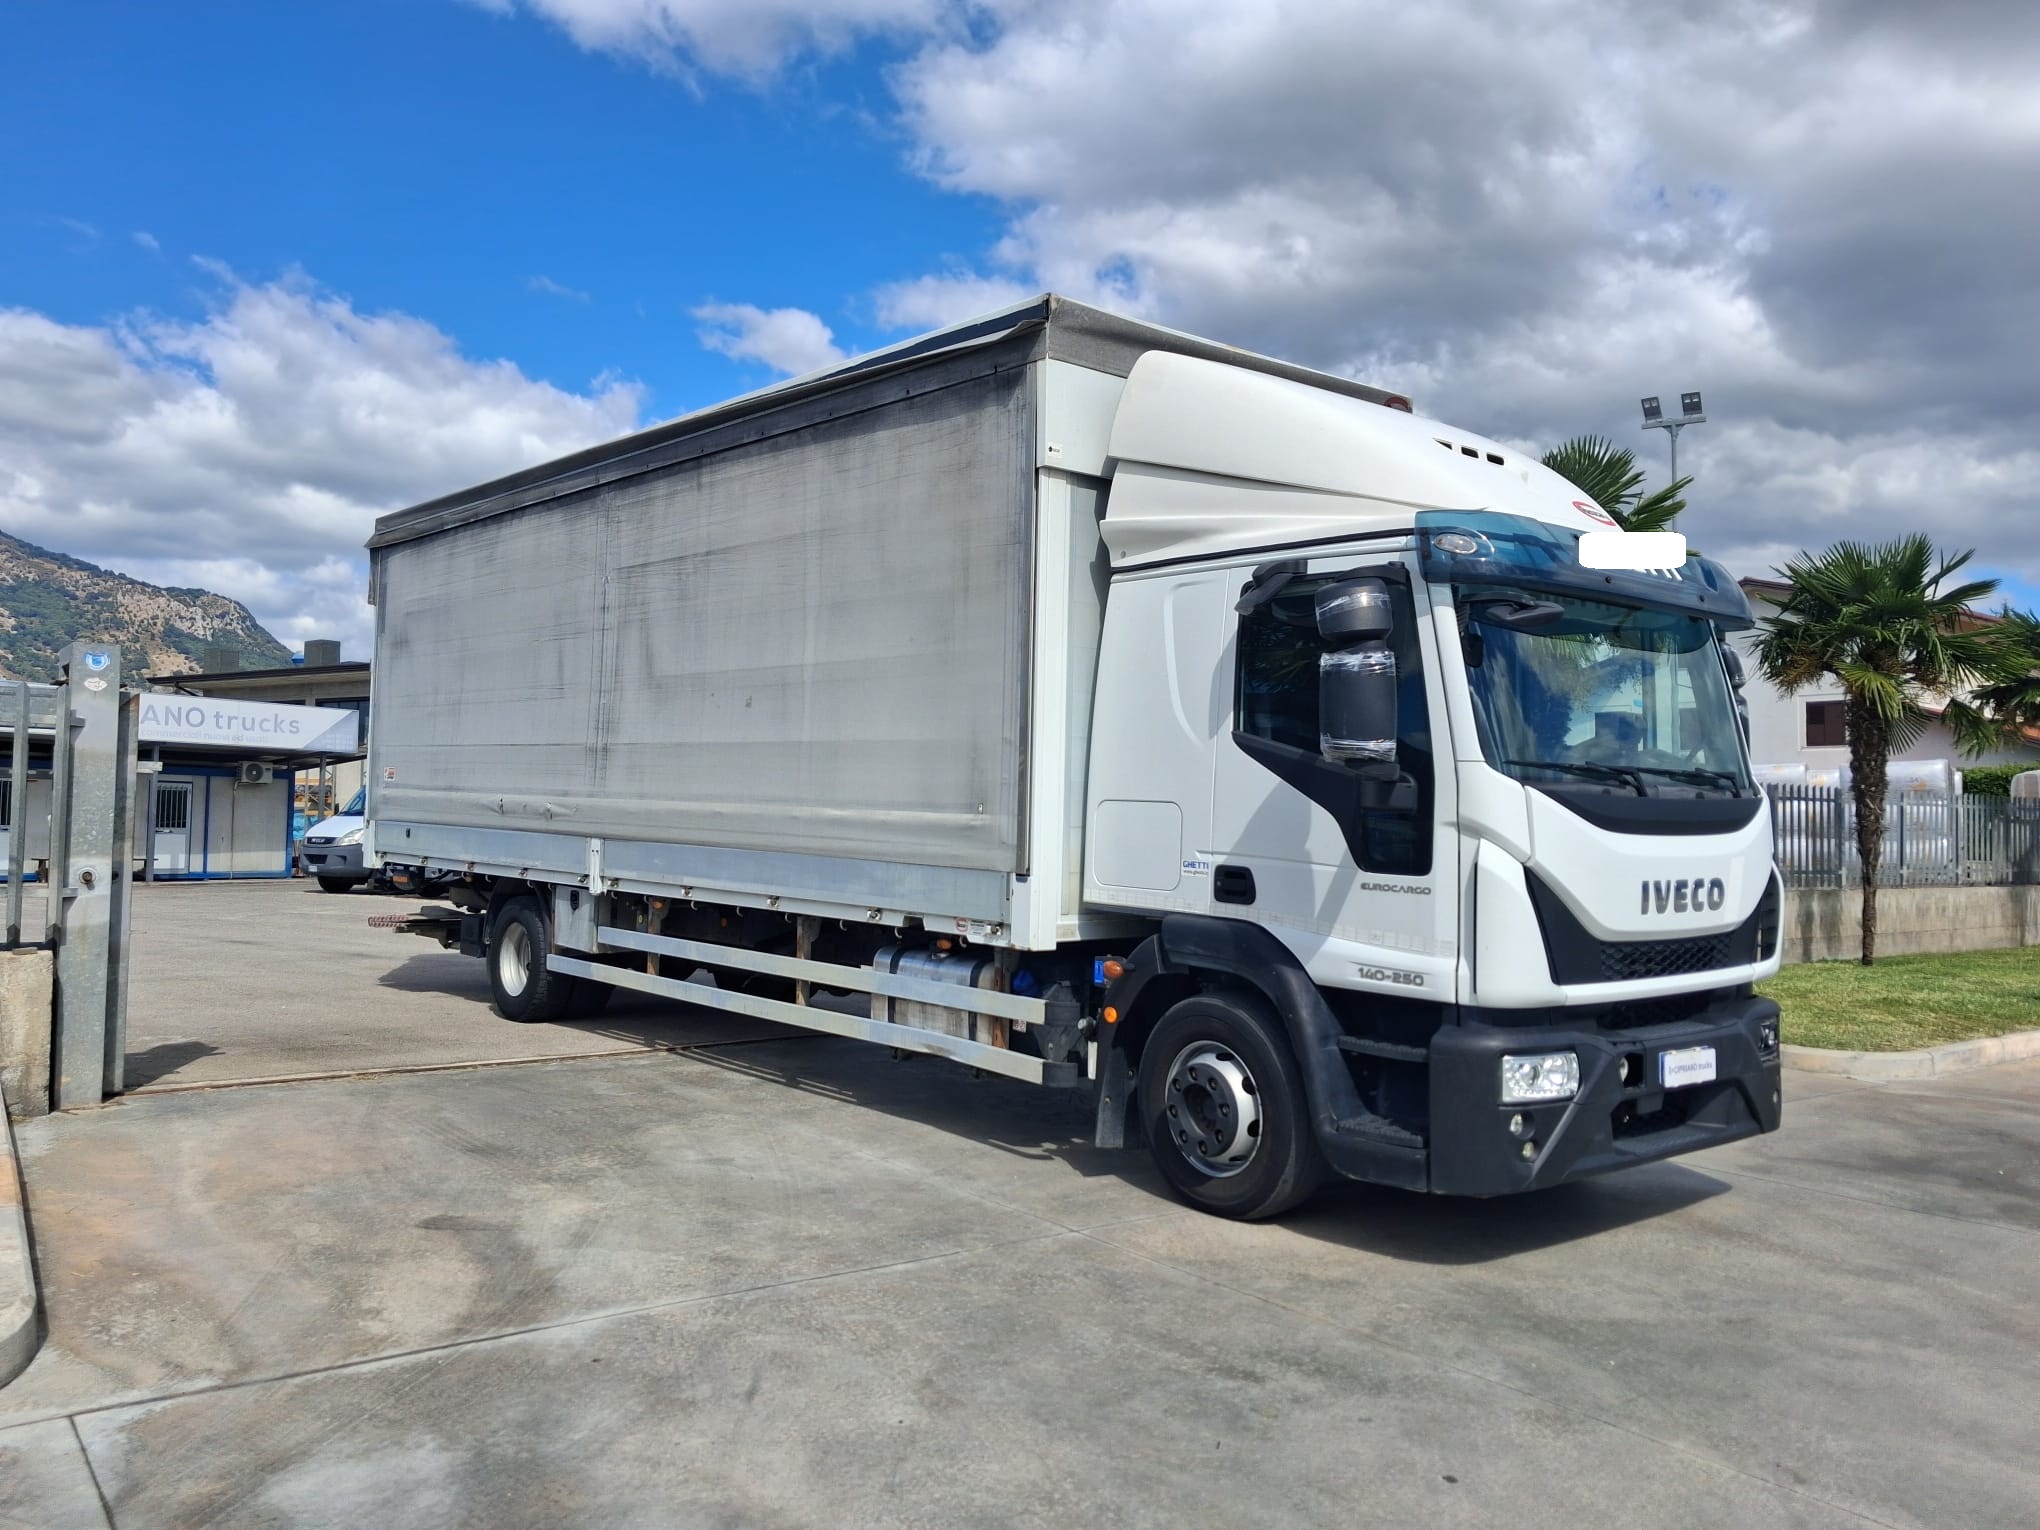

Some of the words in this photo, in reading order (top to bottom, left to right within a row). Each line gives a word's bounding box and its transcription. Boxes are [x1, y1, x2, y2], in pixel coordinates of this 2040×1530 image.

[140, 704, 205, 728] ANO
[213, 711, 300, 734] trucks
[1183, 860, 1209, 869] GHETTI
[1360, 882, 1432, 895] EUROCARGO
[1640, 877, 1726, 916] IVECO
[1358, 967, 1425, 987] 140-250
